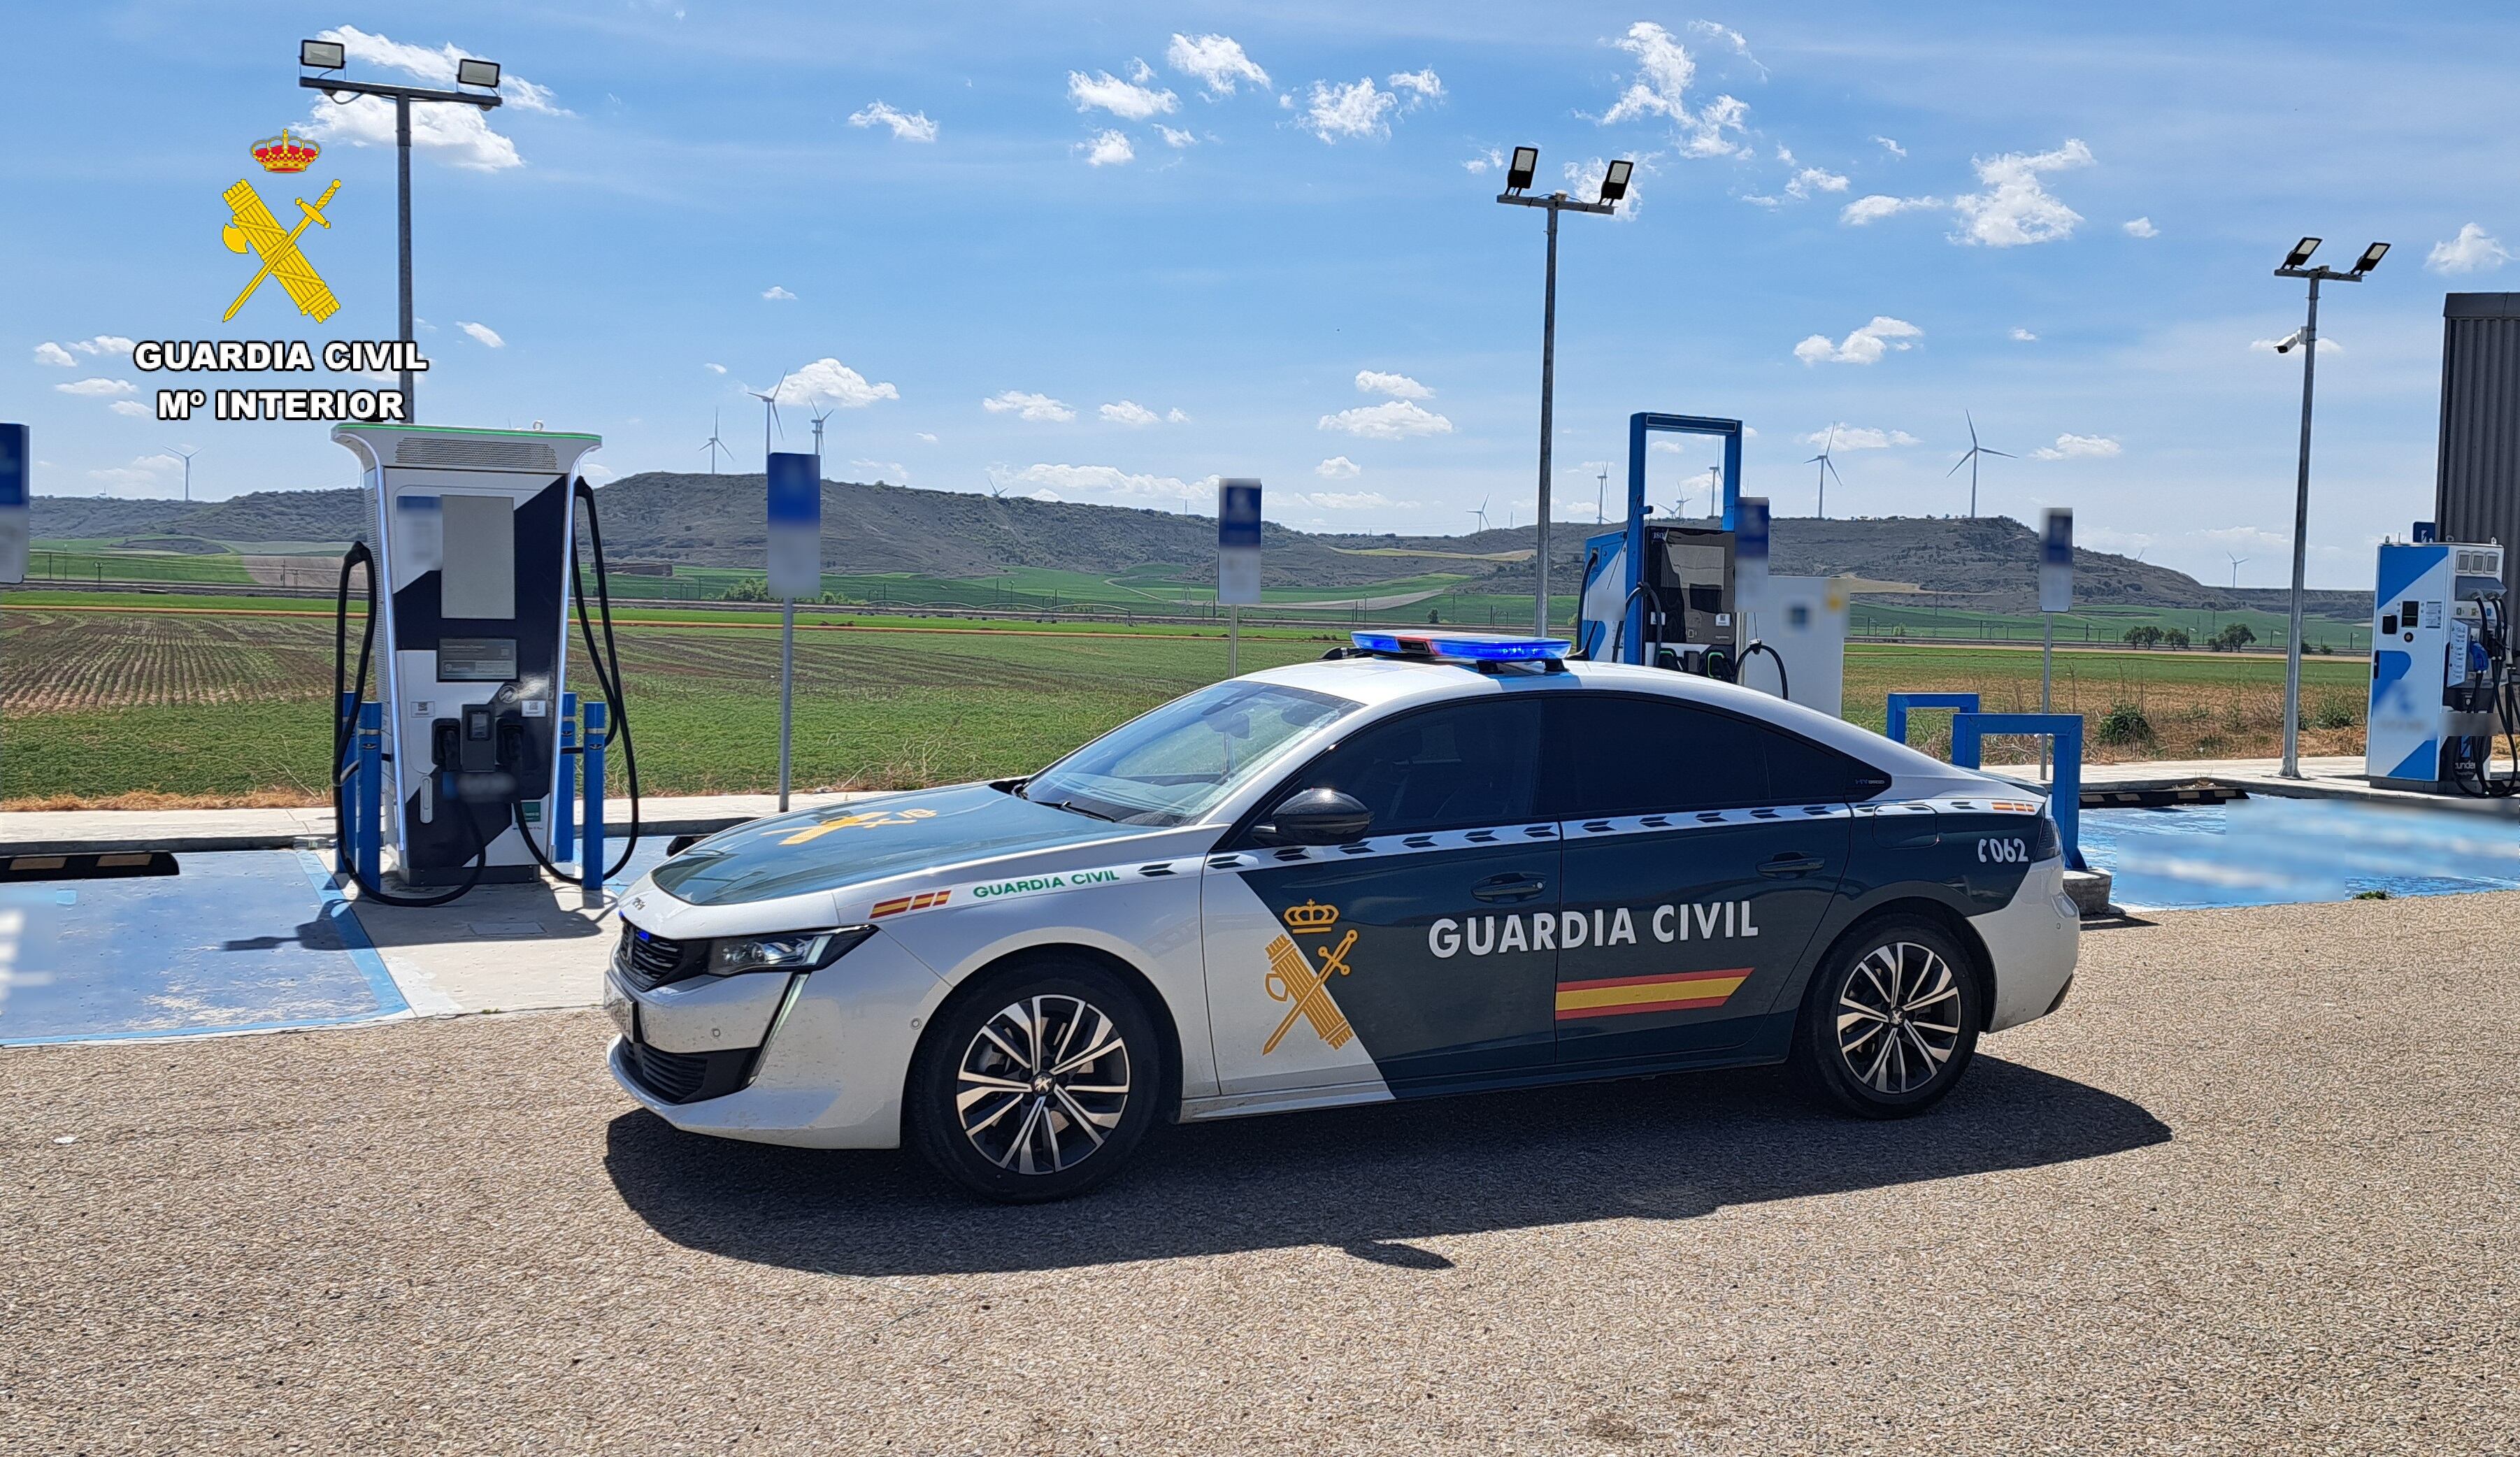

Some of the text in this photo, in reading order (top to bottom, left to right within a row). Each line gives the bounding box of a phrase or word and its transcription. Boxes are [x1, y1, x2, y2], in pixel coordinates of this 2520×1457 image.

[1989, 838, 2029, 863] 062
[973, 870, 1120, 898] GUARDIA CIVIL
[1429, 900, 1759, 959] GUARDIA CIVIL
